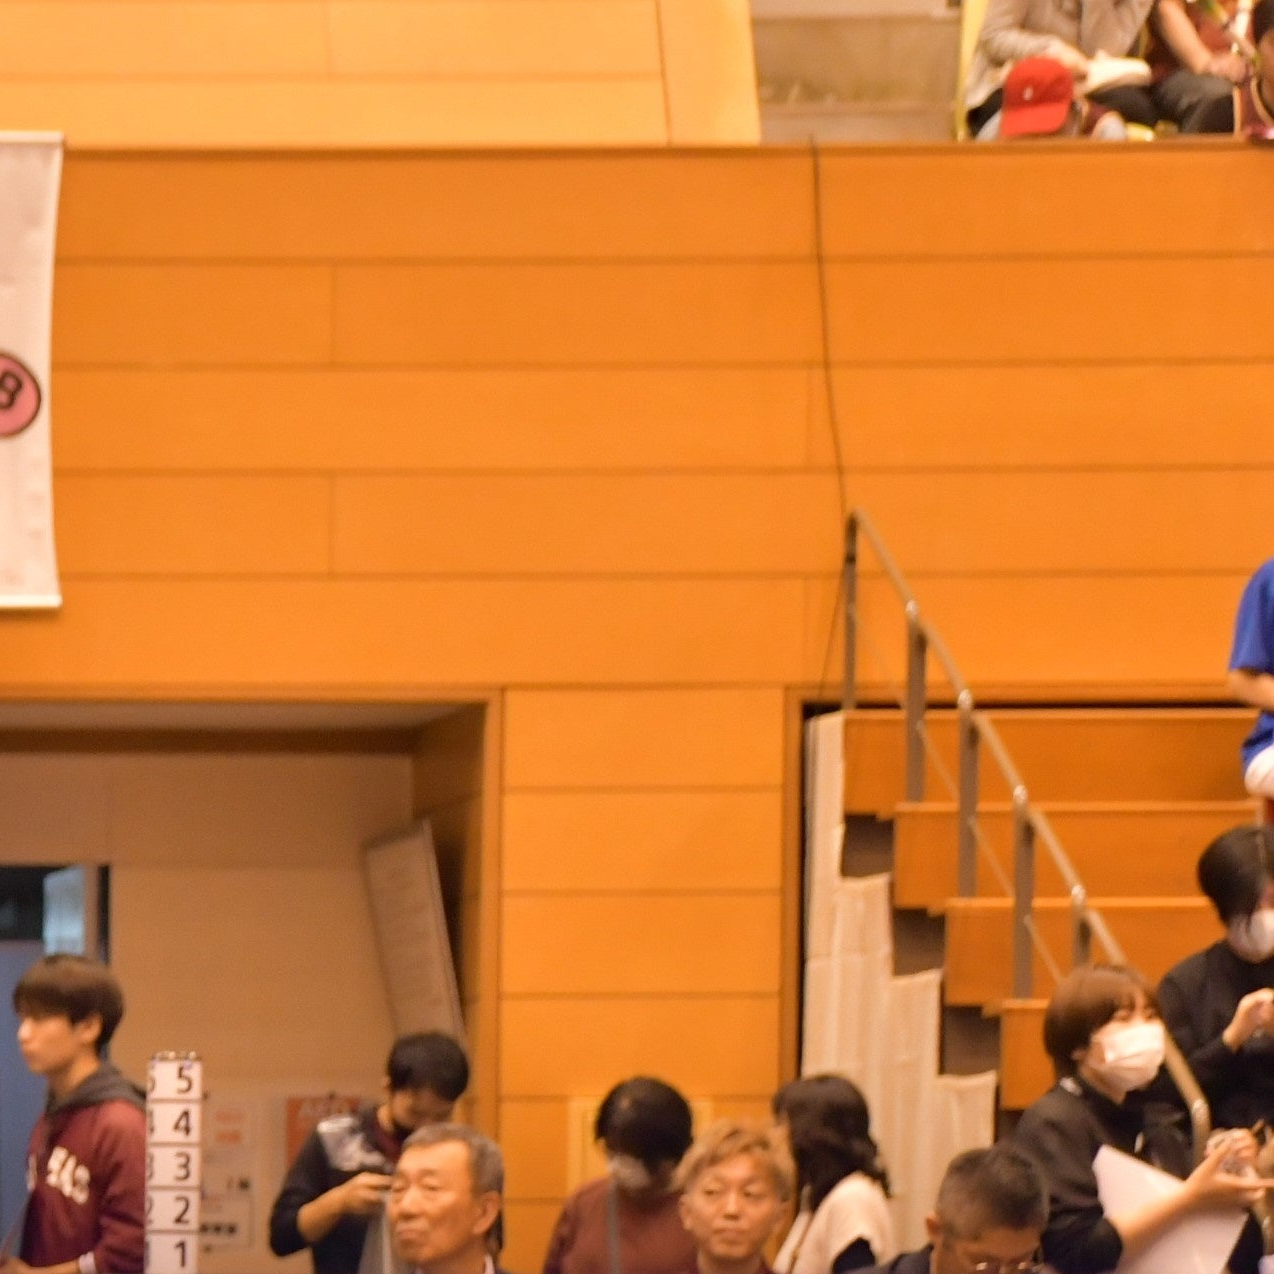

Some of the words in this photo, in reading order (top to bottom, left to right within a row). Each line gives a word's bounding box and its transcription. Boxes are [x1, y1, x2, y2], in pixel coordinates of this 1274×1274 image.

[177, 1066, 193, 1094] 5
[173, 1109, 193, 1135] 4
[174, 1153, 192, 1179] 3
[174, 1197, 191, 1224] 2
[176, 1241, 188, 1269] 1
